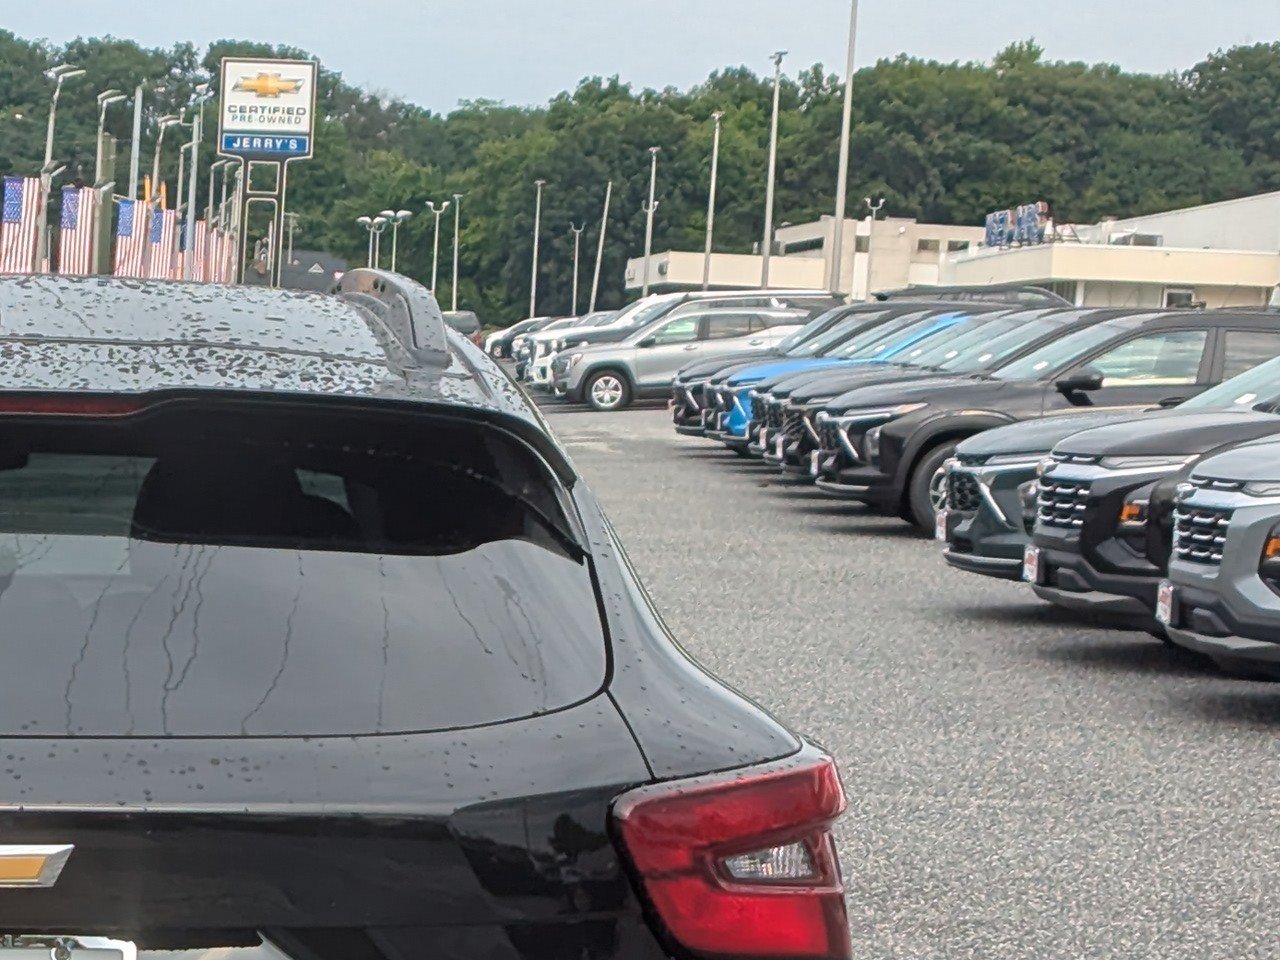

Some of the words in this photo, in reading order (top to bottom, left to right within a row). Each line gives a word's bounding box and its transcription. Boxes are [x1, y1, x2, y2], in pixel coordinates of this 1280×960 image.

[227, 105, 307, 115] CERTIFIED
[231, 115, 302, 124] PRE-OWNED
[232, 137, 298, 149] JERRY'S
